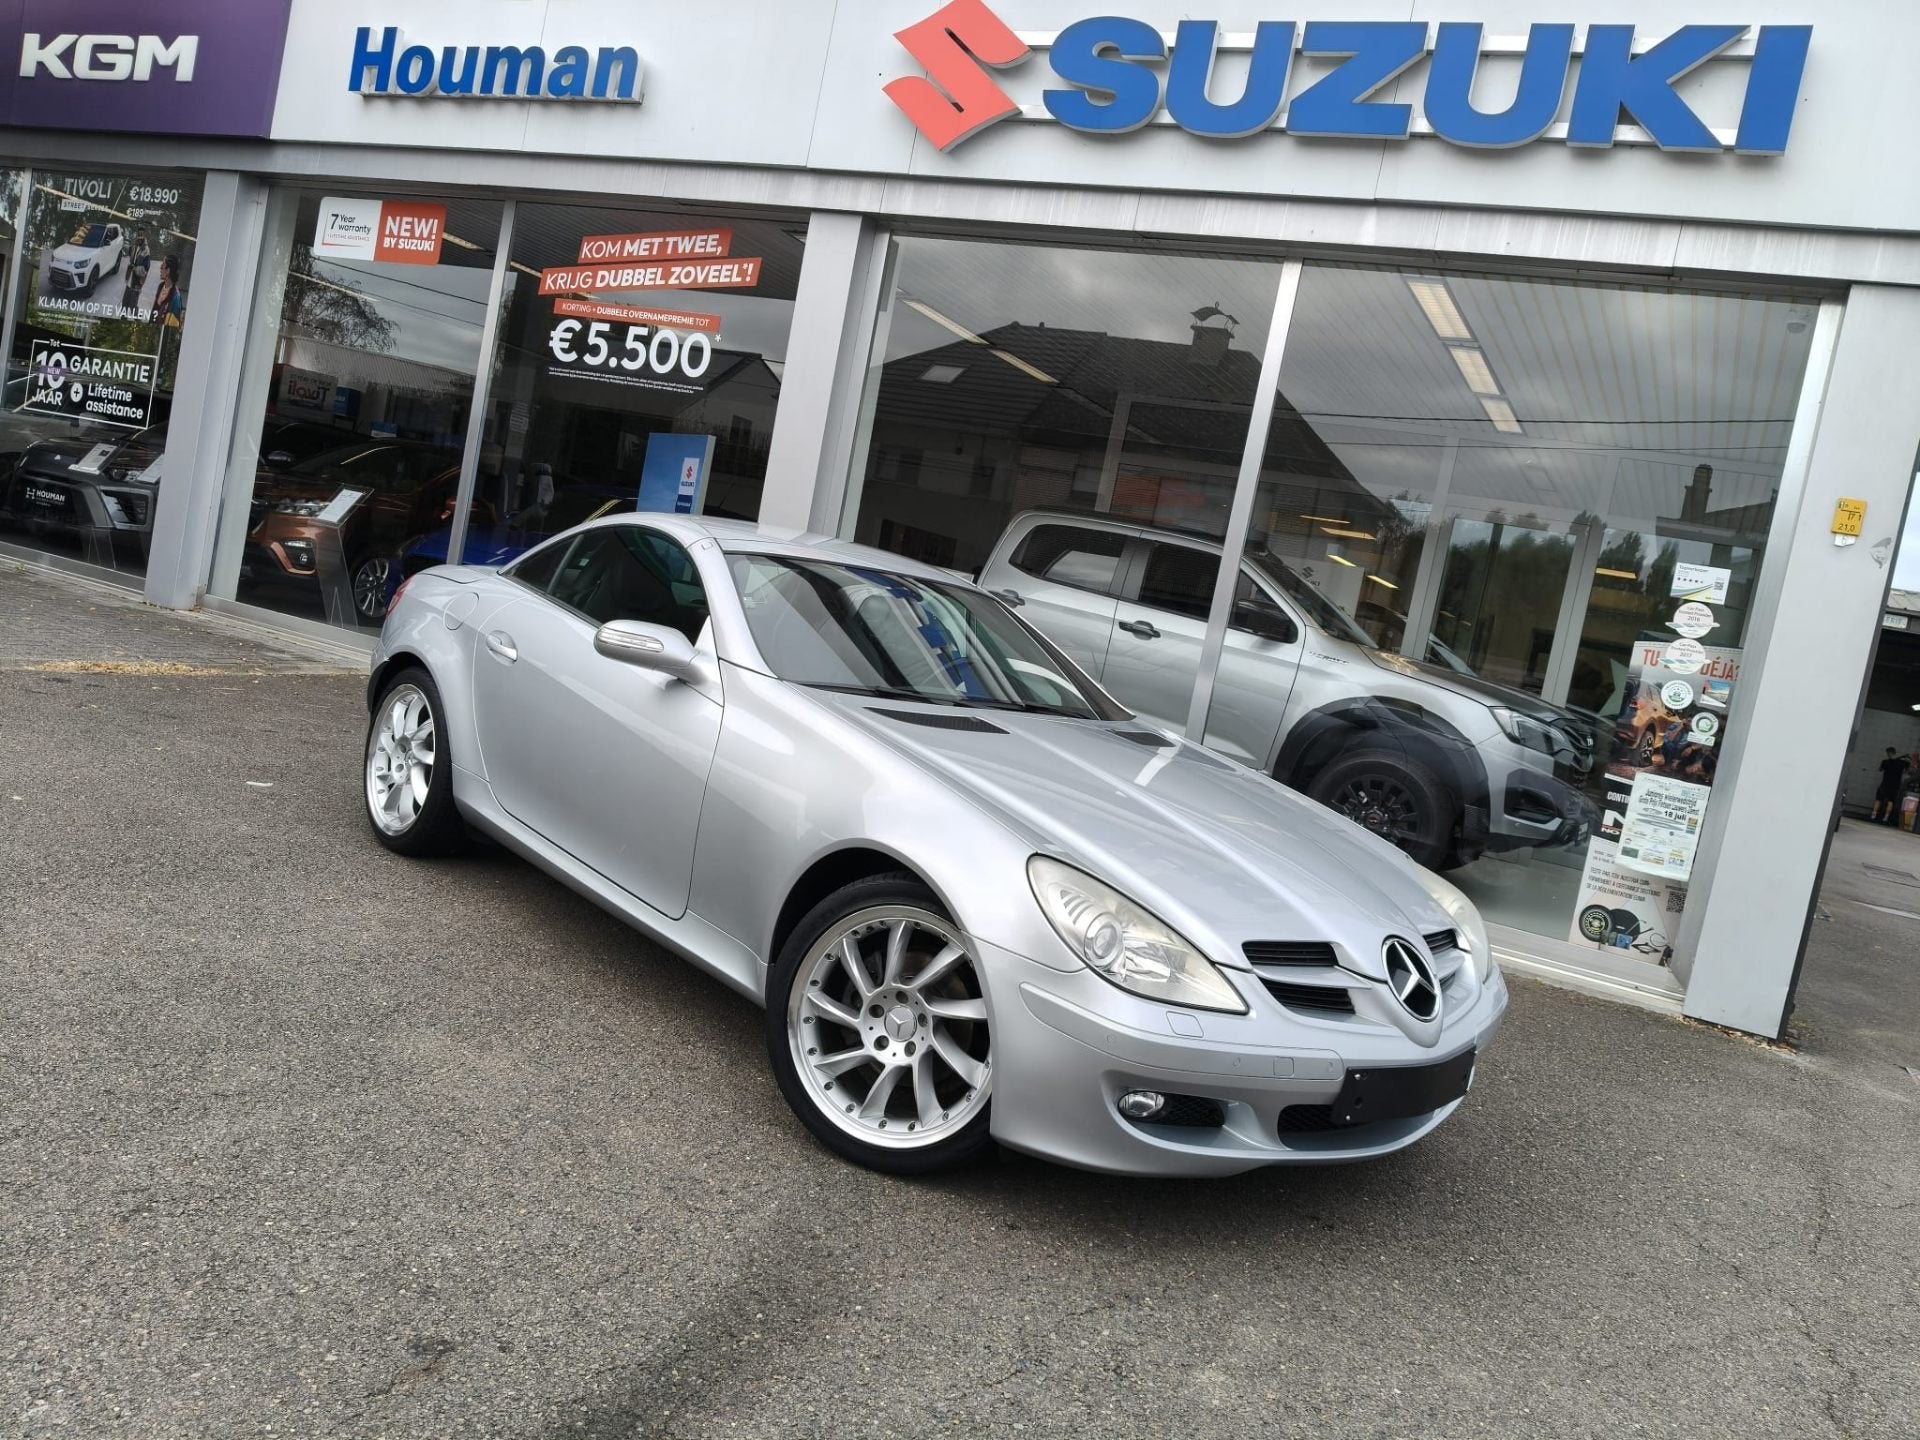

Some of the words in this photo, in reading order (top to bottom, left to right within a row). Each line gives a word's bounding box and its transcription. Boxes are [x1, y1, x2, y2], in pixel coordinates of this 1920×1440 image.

[19, 33, 198, 82] KGM
[348, 26, 640, 98] Houman
[1043, 16, 1813, 157] SUZUKI
[64, 177, 111, 200] TIVOLI
[330, 213, 339, 230] 7
[340, 214, 356, 224] Year
[385, 216, 439, 239] NEW!
[338, 224, 372, 235] warranty
[383, 237, 397, 248] BY
[398, 239, 435, 252] SUZUKI
[581, 240, 622, 259] KOM
[623, 237, 664, 257] MET
[665, 234, 723, 256] TWEE,
[545, 271, 593, 290] KRIJG
[595, 268, 666, 288] DUBBEL
[38, 295, 69, 311] KLAAR
[70, 299, 86, 312] OM
[87, 302, 101, 315] OP
[101, 304, 114, 316] TE
[115, 305, 151, 322] VALLEN
[152, 310, 159, 322] ?
[562, 303, 593, 314] KORTING
[596, 306, 629, 318] DUBBELE
[629, 310, 695, 326] OVERNAMEPREMIE
[695, 317, 710, 327] TOT
[49, 338, 61, 348] Tot
[70, 355, 150, 383] GARANTIE
[32, 387, 63, 406] JAAR
[88, 382, 133, 402] Lifetime
[86, 400, 144, 419] assistance
[37, 490, 65, 502] HOUMAN
[1643, 649, 1659, 667] TU
[1674, 812, 1687, 821] juli
